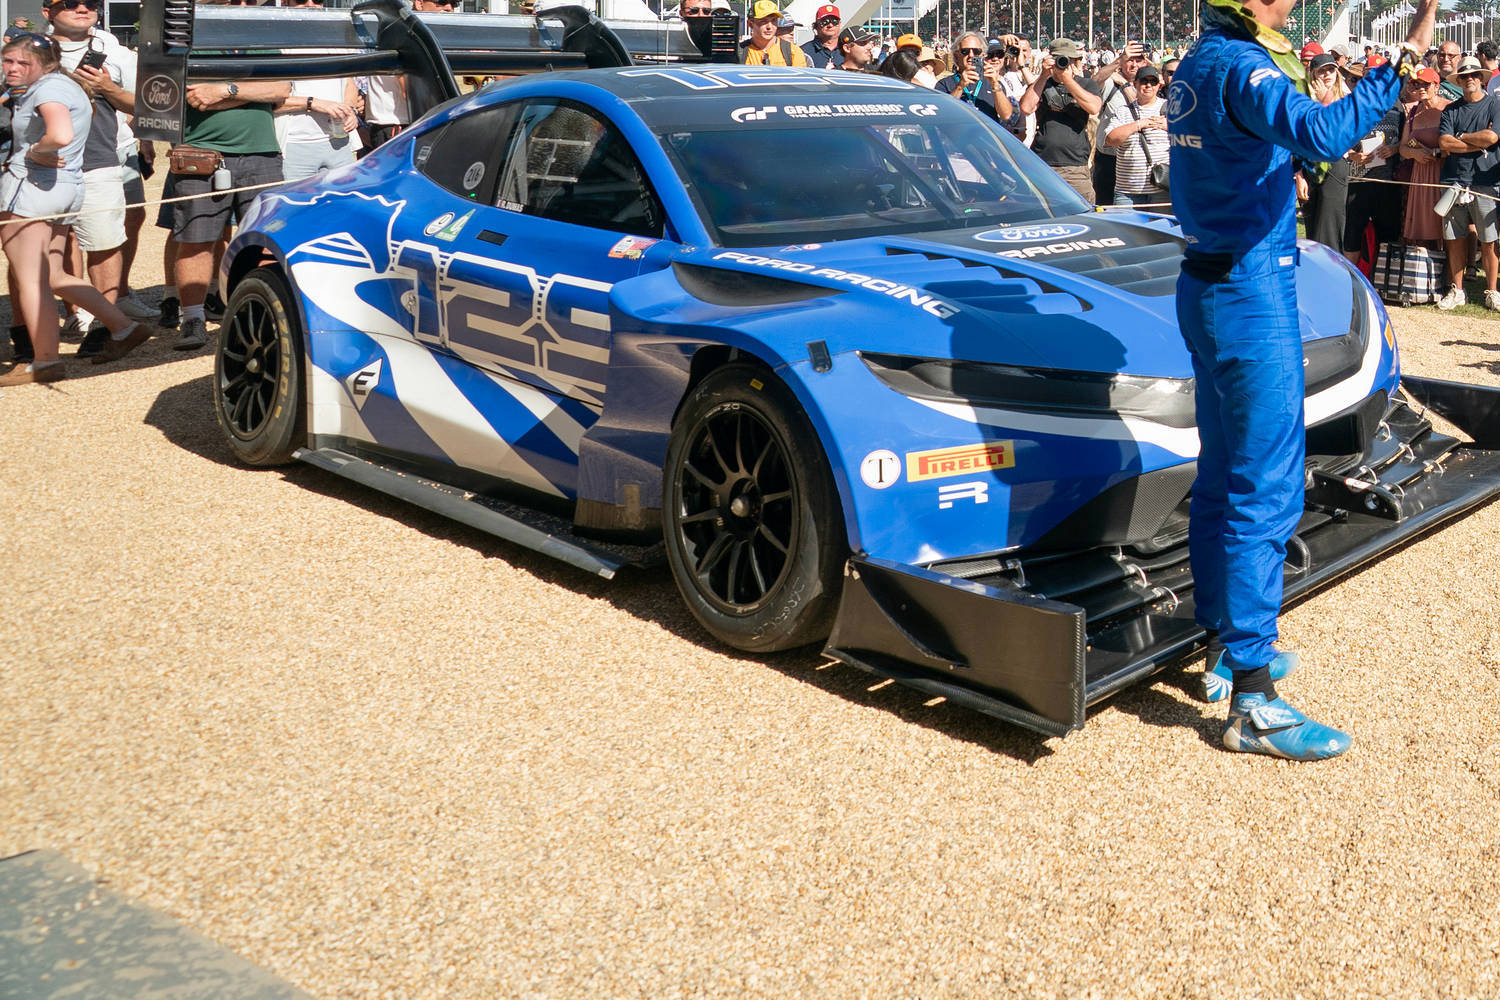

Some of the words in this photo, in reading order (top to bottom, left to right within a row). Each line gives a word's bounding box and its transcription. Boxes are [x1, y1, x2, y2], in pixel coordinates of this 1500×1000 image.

[148, 80, 173, 105] Ford
[783, 105, 832, 115] GRAN
[833, 104, 904, 113] TURISMO
[138, 117, 180, 131] RACING
[1000, 226, 1070, 239] Ford
[997, 237, 1126, 258] RACING
[712, 251, 816, 272] FORD
[810, 267, 961, 320] RACING
[352, 371, 376, 396] E
[868, 457, 894, 484] T
[918, 445, 1005, 477] PIRELLI
